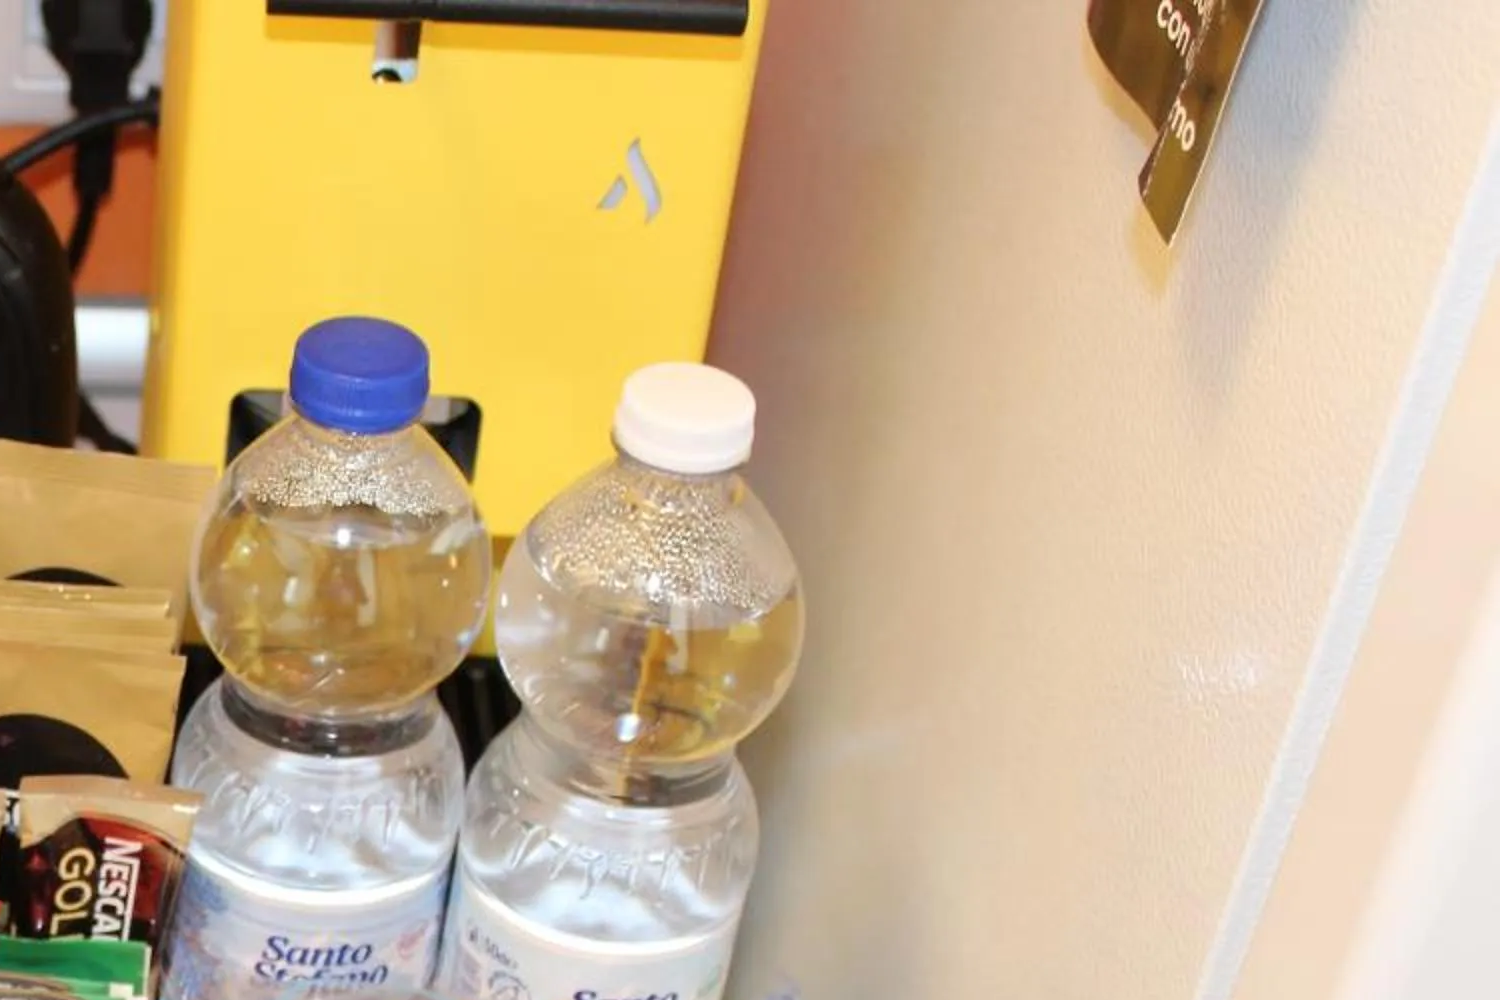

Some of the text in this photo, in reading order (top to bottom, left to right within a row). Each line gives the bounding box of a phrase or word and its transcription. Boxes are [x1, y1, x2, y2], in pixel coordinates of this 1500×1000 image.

[51, 847, 97, 942] GOL
[91, 836, 144, 942] NESCA
[262, 935, 373, 967] Santo
